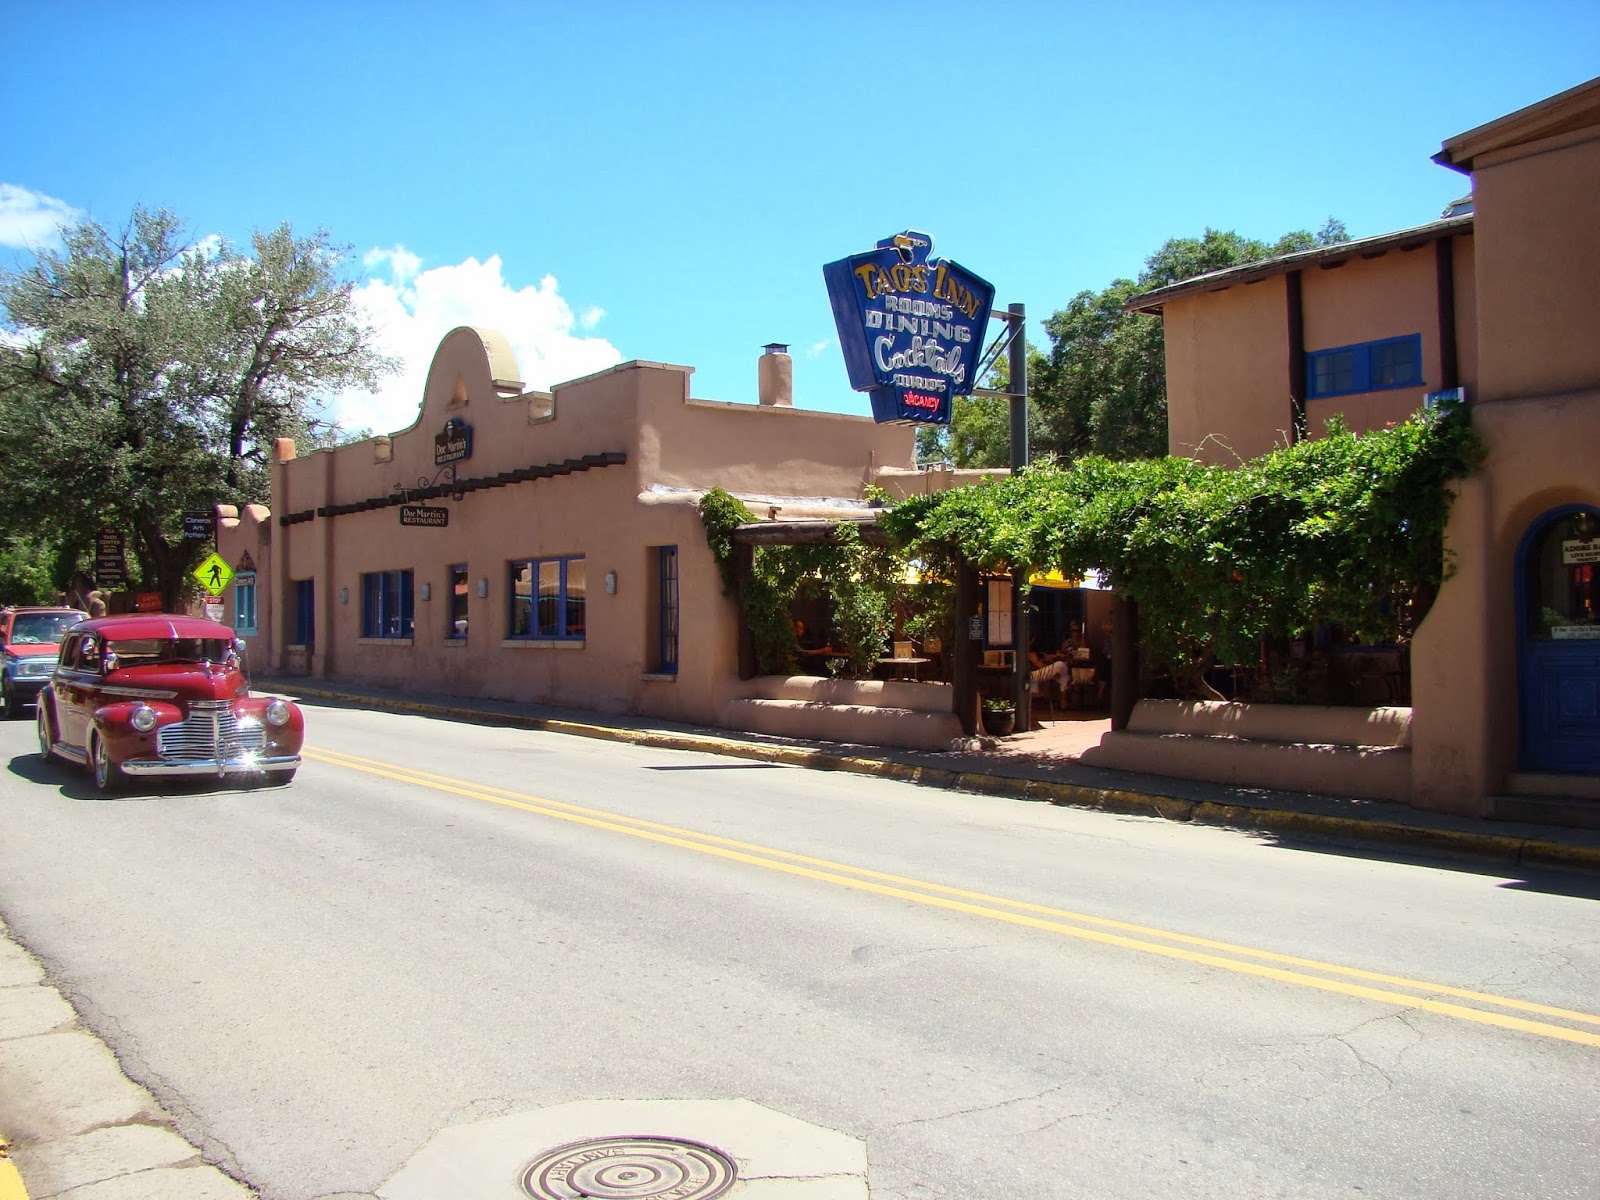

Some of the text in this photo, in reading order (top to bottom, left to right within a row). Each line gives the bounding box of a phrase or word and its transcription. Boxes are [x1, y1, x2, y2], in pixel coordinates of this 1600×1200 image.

[853, 263, 980, 320] TAOS INN
[885, 295, 953, 321] ROOMS
[865, 310, 971, 343] DINING
[874, 333, 965, 384] Cocktails
[436, 444, 447, 456] Doc
[437, 451, 465, 463] RESTAURANT
[403, 509, 446, 519] Doc Martin's
[403, 517, 446, 525] RESTAURANT
[645, 1177, 708, 1200] EWER
